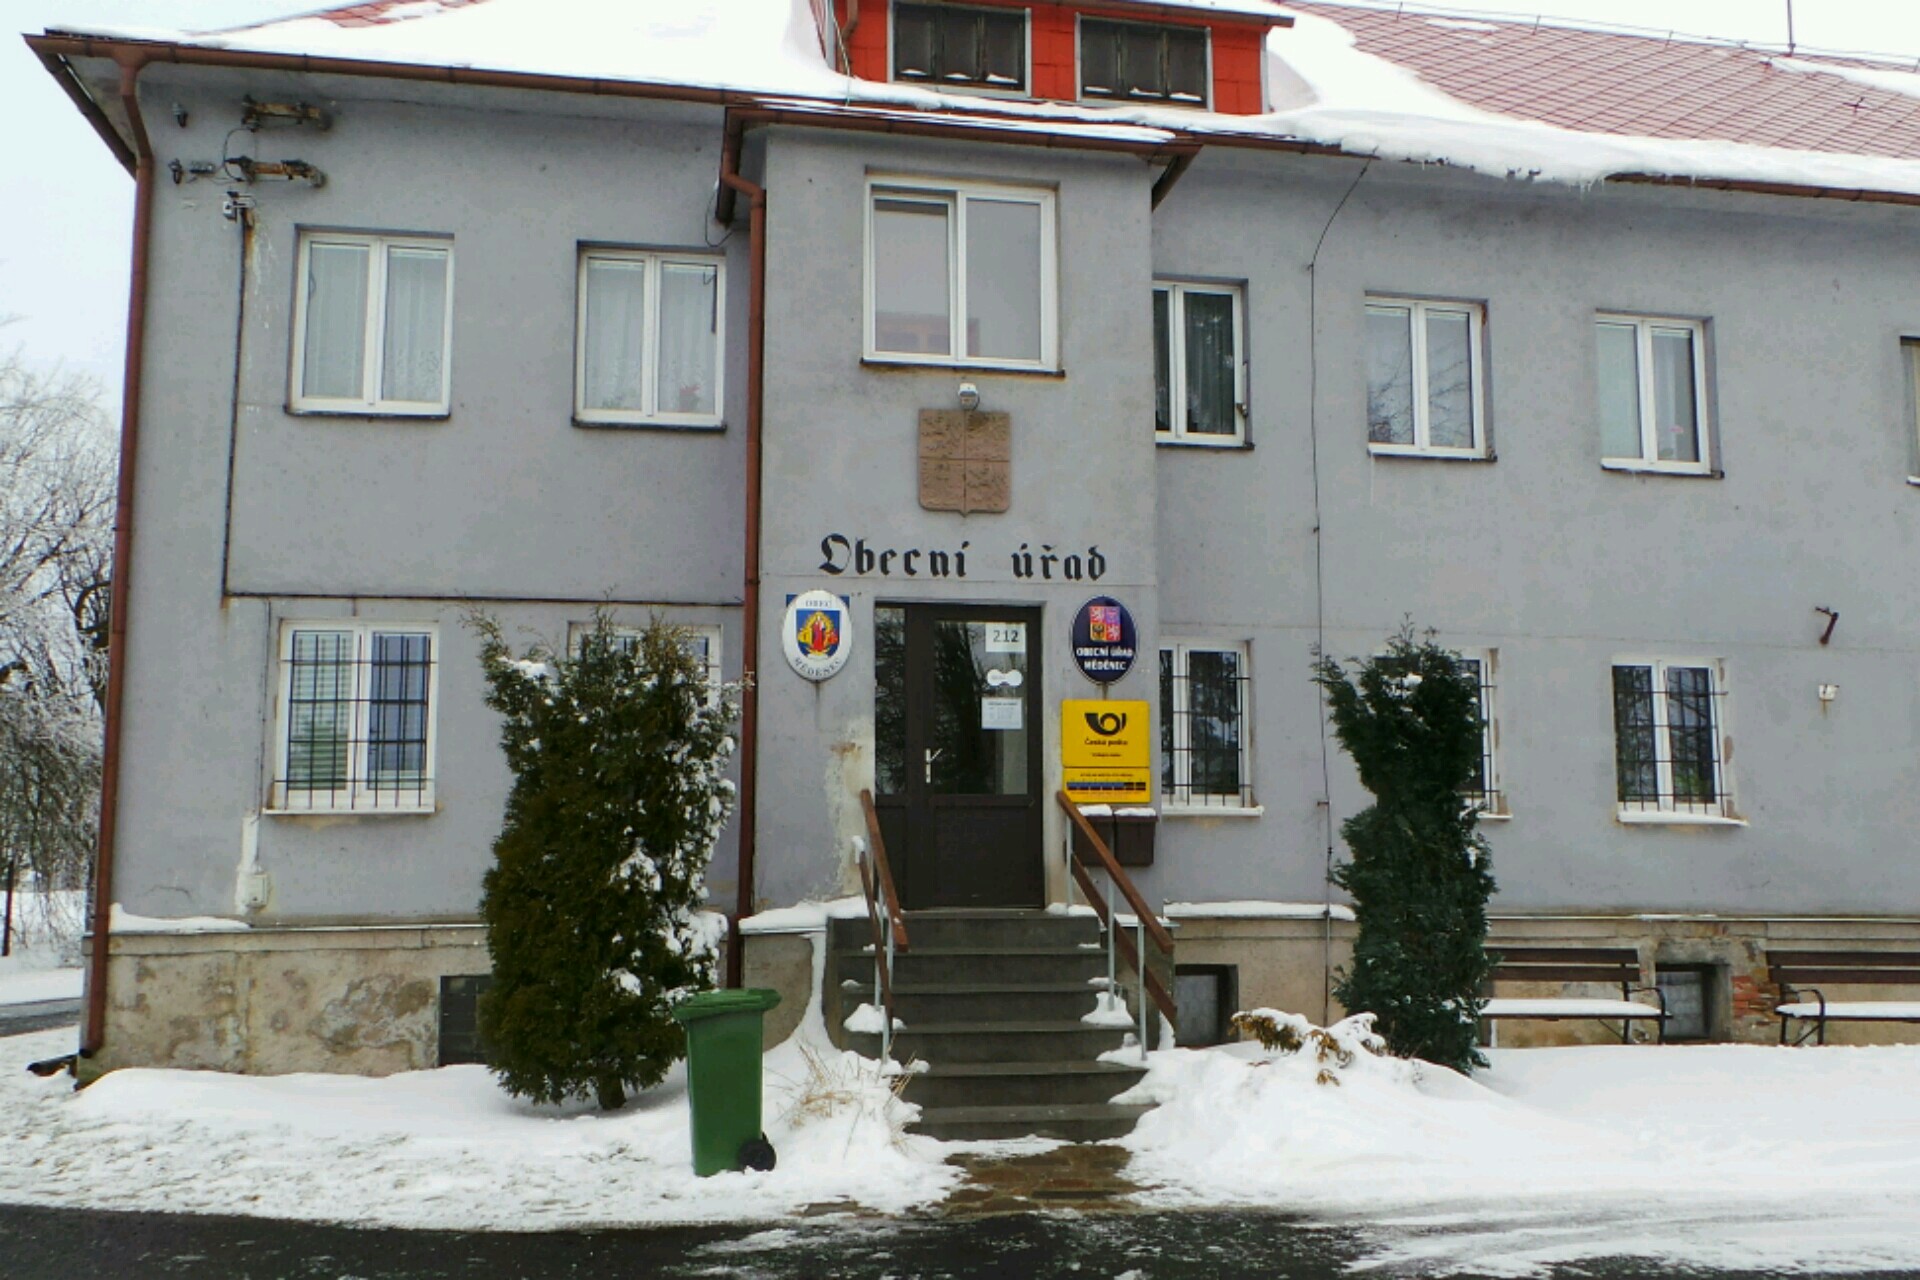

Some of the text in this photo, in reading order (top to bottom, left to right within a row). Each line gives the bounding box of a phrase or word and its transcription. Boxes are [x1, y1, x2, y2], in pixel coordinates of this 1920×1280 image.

[818, 532, 1107, 581] Obecní úřad
[993, 630, 1020, 642] 212
[1084, 659, 1127, 671] MĚDĚNEC
